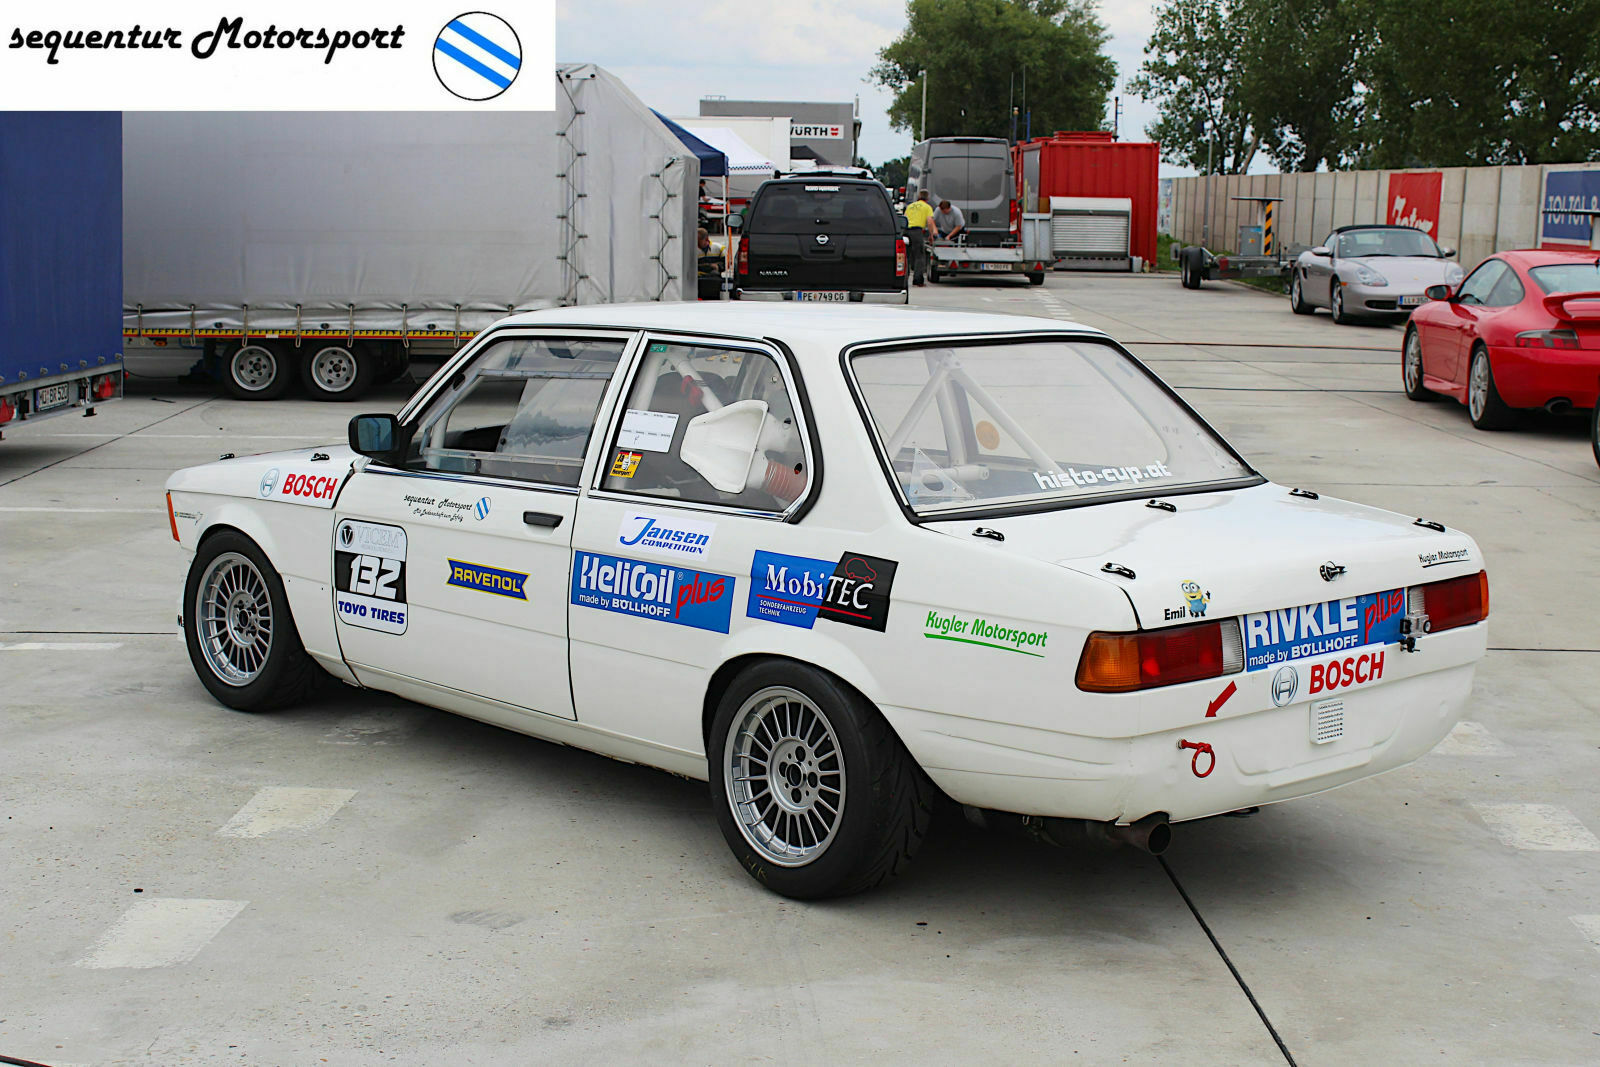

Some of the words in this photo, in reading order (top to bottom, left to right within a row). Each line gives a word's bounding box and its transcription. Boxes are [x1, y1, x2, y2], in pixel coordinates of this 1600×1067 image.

[790, 125, 828, 136] ÜRTH
[803, 292, 813, 301] PE
[818, 292, 833, 301] 749
[282, 474, 338, 500] BOSCH
[1033, 460, 1173, 490] histo-cup.at
[438, 498, 473, 513] Motorsport
[357, 525, 400, 549] VICEM
[620, 516, 710, 546] Jansen
[641, 538, 705, 555] COMPETITION
[1418, 552, 1438, 564] Kugler
[1438, 549, 1468, 561] Motorsport
[350, 554, 402, 600] 132
[454, 567, 521, 593] RAVENOL
[579, 594, 599, 605] made
[600, 599, 610, 609] by
[612, 597, 671, 618] BÖLLHOFF
[674, 573, 726, 619] plus
[759, 599, 807, 615] SONDERFAHRZEUG
[371, 607, 406, 625] TIRES
[759, 606, 781, 617] TECHNIK
[1164, 605, 1186, 621] Emil
[1246, 596, 1359, 649] RIVKLE
[1364, 588, 1405, 644] plus
[925, 610, 969, 635] Kugler
[970, 618, 1048, 648] Motorsport
[1249, 650, 1275, 667] made
[1277, 649, 1289, 662] by
[1291, 634, 1359, 659] BÖLLHOFF
[1309, 651, 1385, 695] BOSCH
